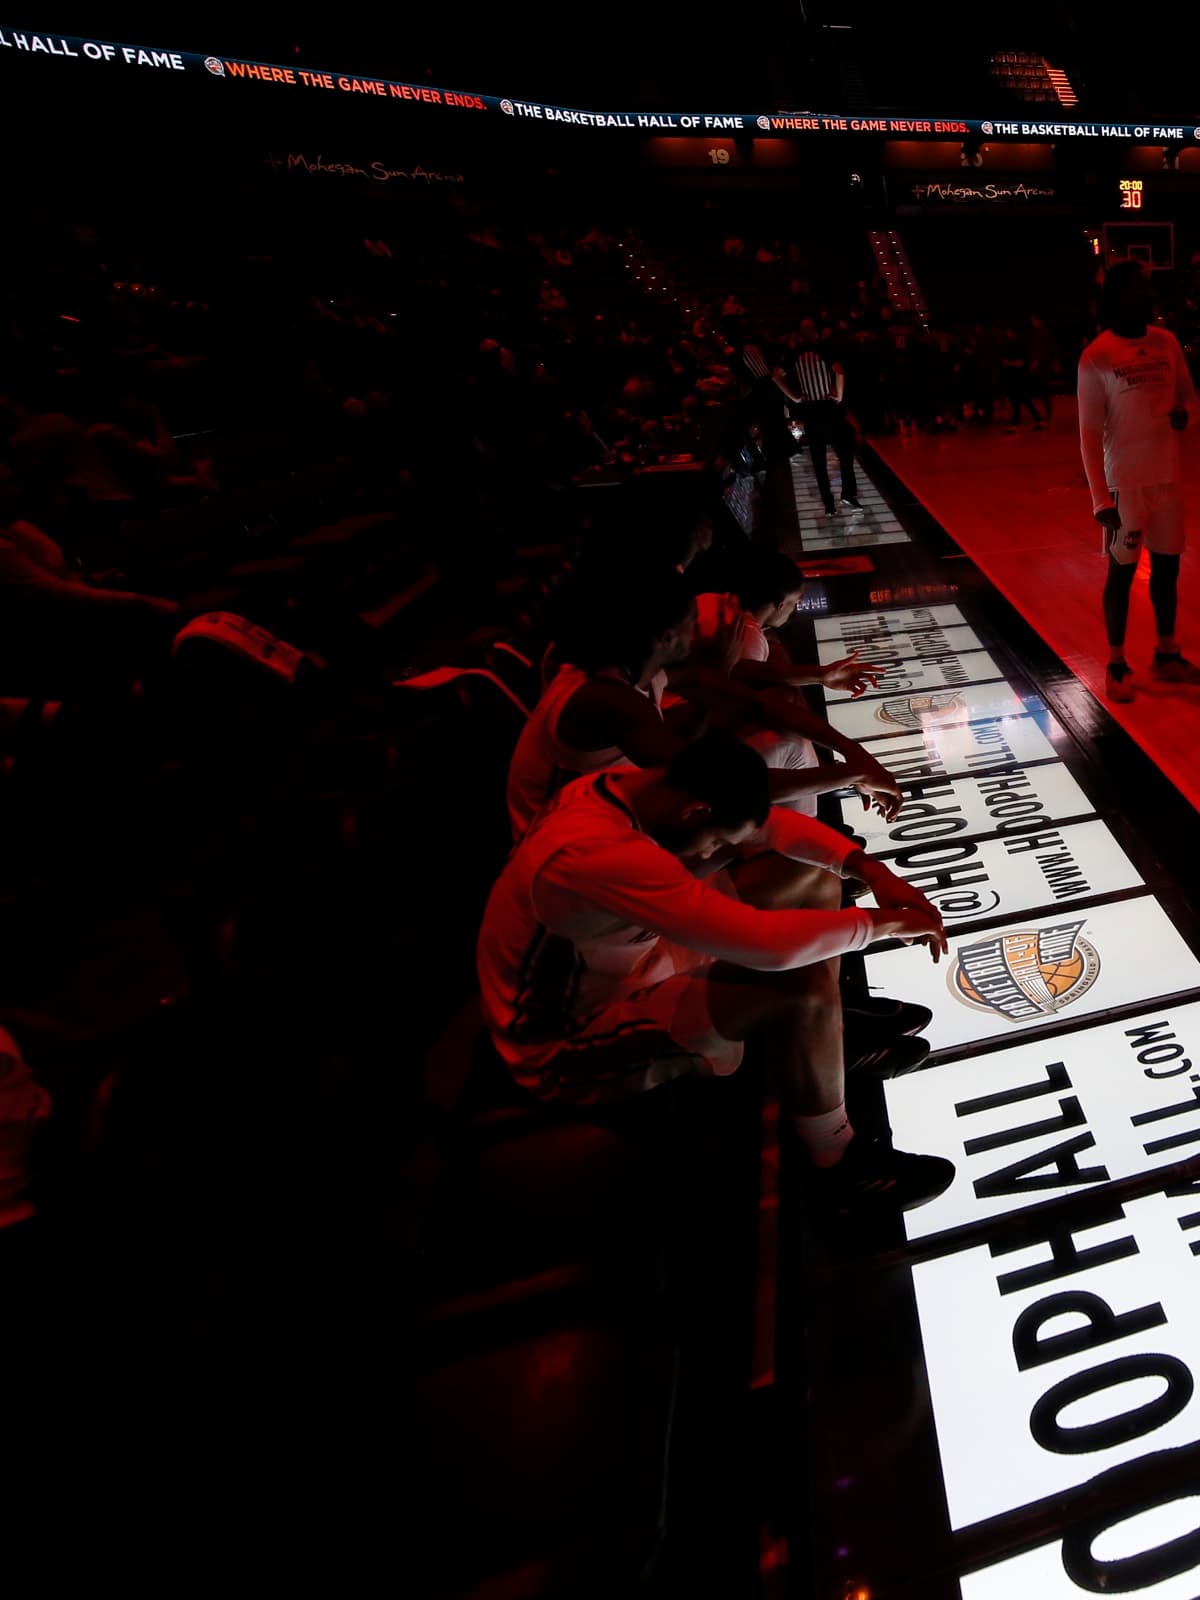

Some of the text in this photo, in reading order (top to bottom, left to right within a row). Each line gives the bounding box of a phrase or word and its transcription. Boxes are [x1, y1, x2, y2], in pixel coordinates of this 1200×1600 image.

[13, 31, 79, 57] HALL
[82, 42, 116, 61] OF
[121, 47, 186, 70] FAME
[226, 61, 488, 111] WHERE THE GAME NEVER ENDS.
[514, 102, 744, 129] THE BASKETBALL HALL OF FAME
[771, 118, 970, 133] WHERE THE GAME NEVER ENDS.
[994, 123, 1184, 139] THE BASKETBALL HALL OF FAME
[708, 148, 730, 165] 19
[288, 153, 368, 178] Mohegan
[370, 162, 408, 181] Sun
[927, 181, 1055, 199] Mohegan Sun Arena
[1119, 180, 1143, 191] 20:00
[1121, 191, 1141, 208] 30
[1006, 936, 1038, 953] OF
[1038, 924, 1080, 963] FAME
[961, 942, 1041, 1017] BASKETBALL
